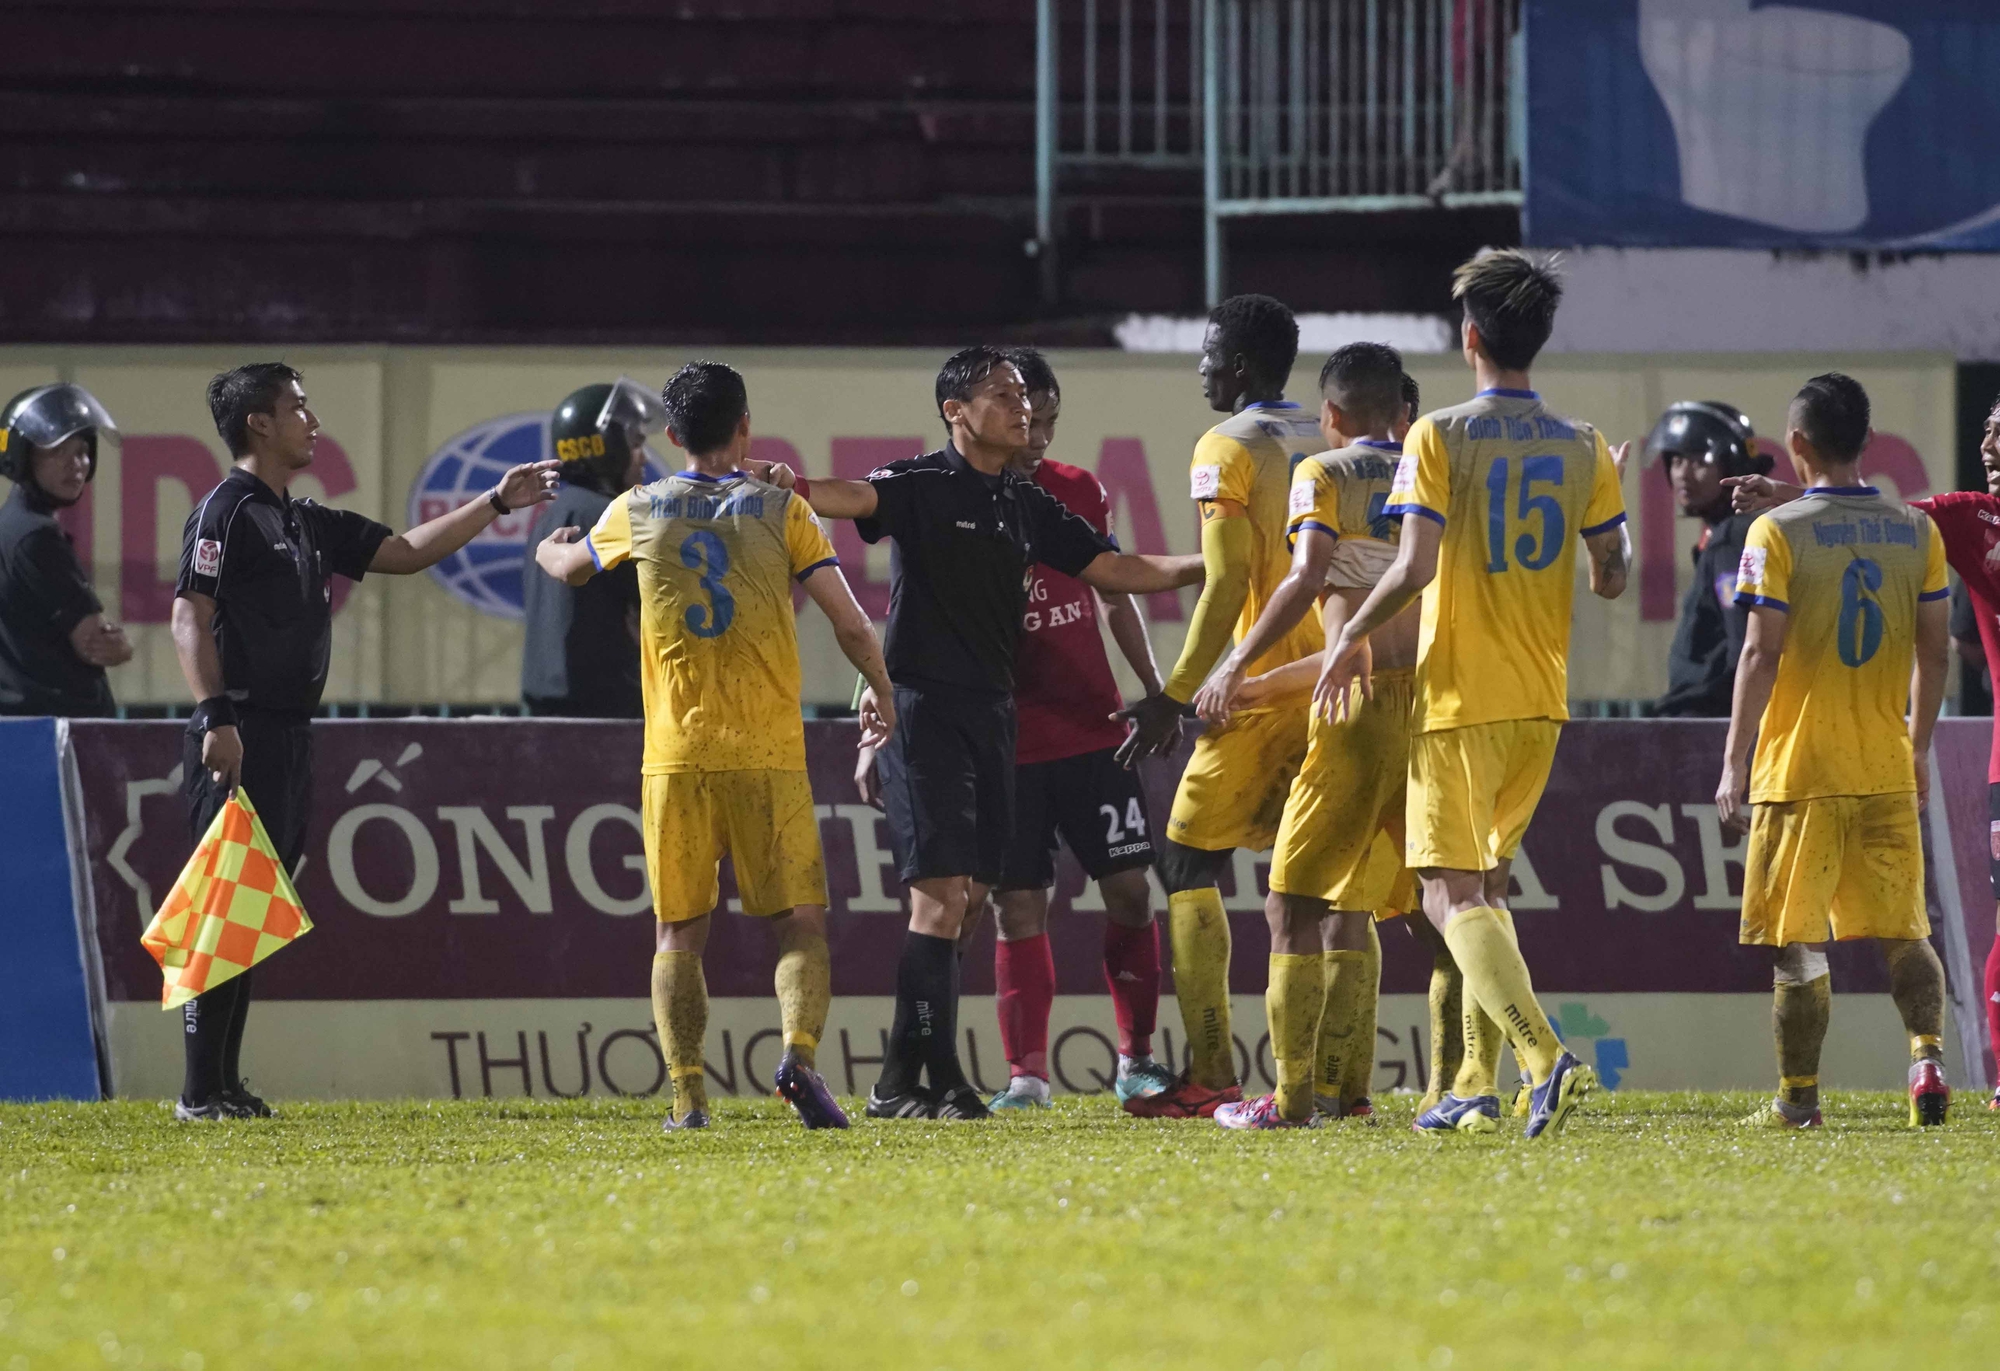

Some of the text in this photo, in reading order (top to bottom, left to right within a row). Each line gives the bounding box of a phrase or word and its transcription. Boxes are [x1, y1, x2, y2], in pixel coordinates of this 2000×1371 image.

[1486, 455, 1566, 574] 15
[197, 562, 217, 574] VPF
[680, 530, 735, 639] 3
[1838, 557, 1884, 669] 6
[1099, 796, 1146, 845] 24
[1107, 841, 1151, 859] Kappa
[915, 1000, 934, 1036] mitre
[1203, 1006, 1221, 1051] mitre
[1464, 1014, 1477, 1060] mitre
[1504, 1002, 1539, 1048] mitre
